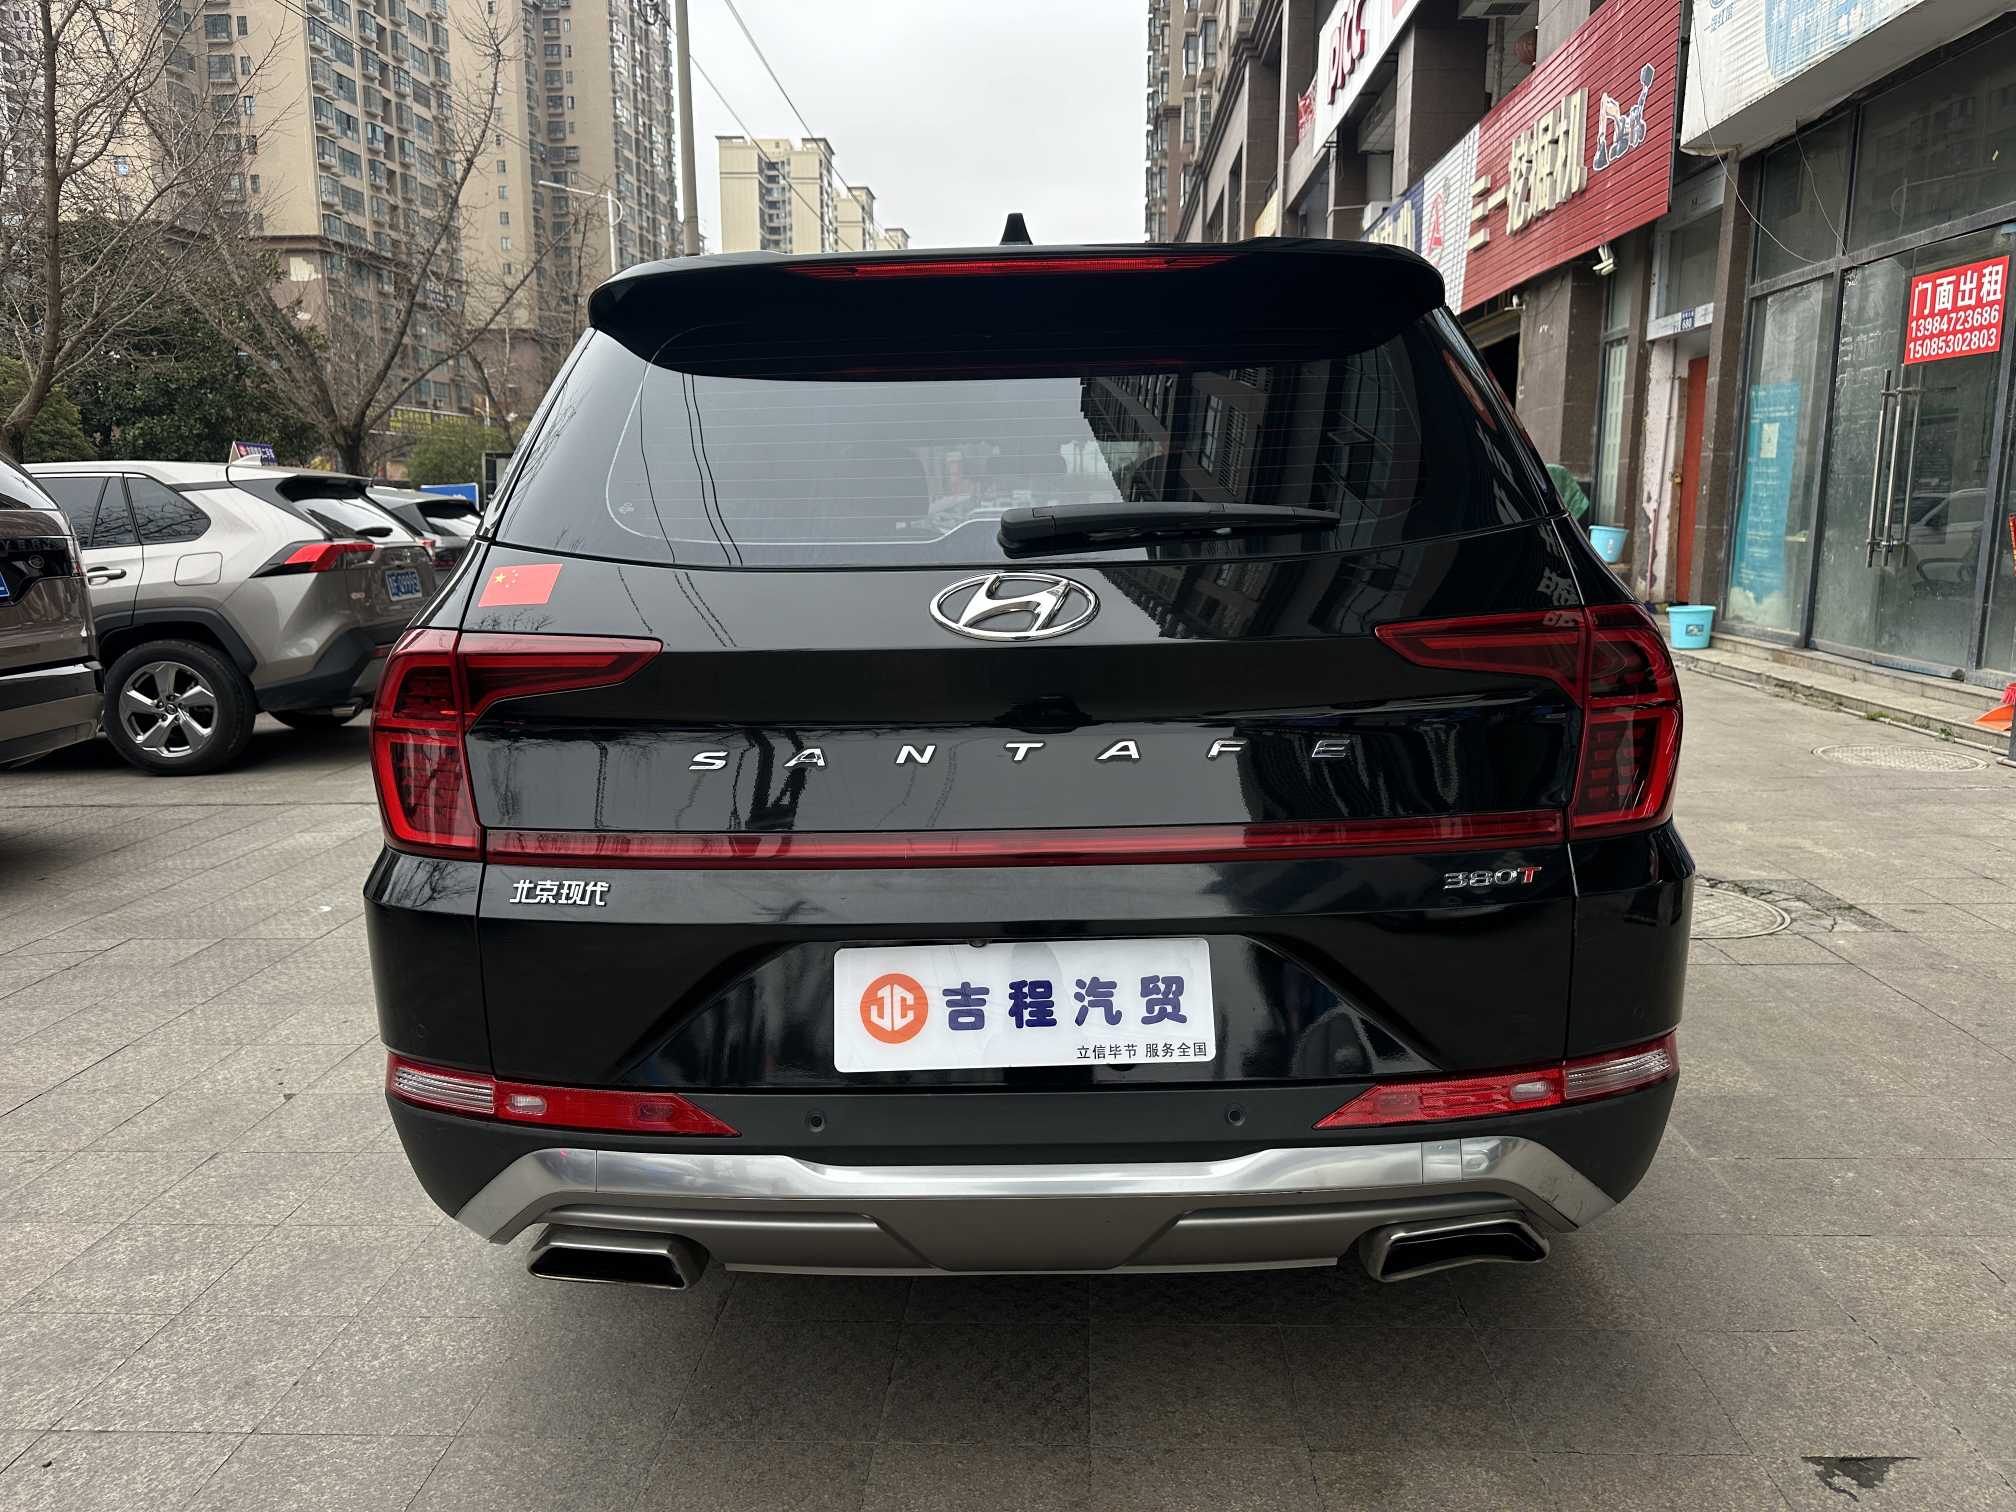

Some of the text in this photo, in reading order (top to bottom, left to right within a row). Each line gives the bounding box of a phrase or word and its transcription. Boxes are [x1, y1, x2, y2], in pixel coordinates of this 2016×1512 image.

[1467, 87, 1588, 251] 三一挖掘机
[1912, 264, 2003, 317] 门面出租
[1911, 304, 2000, 338] 13984723686
[1908, 327, 1997, 359] 15085302803
[688, 738, 1351, 771] SANTA FE
[509, 879, 610, 907] 北京现代
[1443, 866, 1543, 890] 380T
[942, 974, 1188, 1032] 吉程汽贸
[1076, 1041, 1208, 1060] 立信毕节 服务全国
